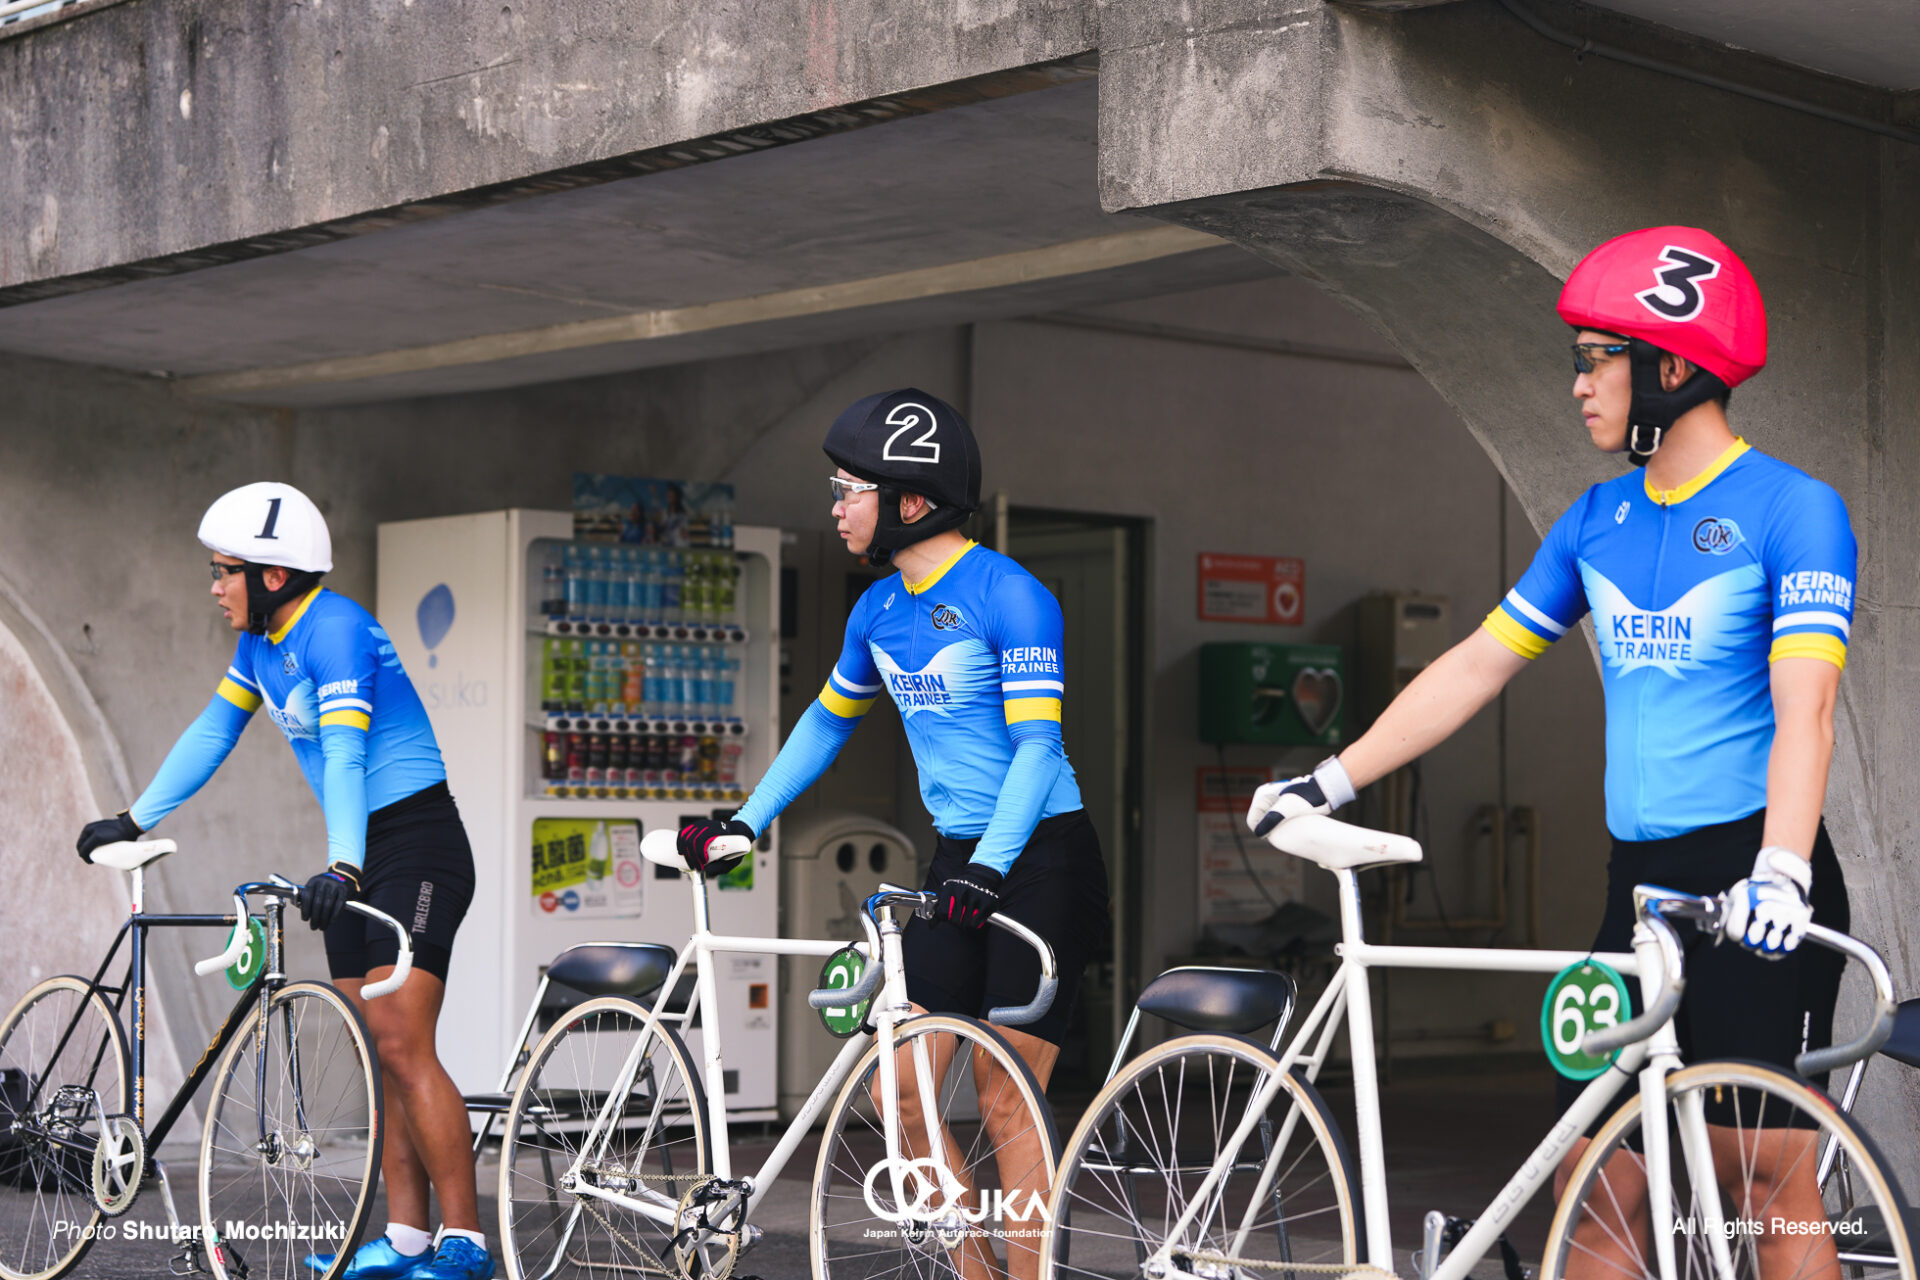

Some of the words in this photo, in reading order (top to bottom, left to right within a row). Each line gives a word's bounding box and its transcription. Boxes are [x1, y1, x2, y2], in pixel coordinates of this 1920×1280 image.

[1634, 245, 1721, 322] 3
[883, 402, 940, 463] 2
[254, 497, 281, 539] 1
[1780, 571, 1852, 598] KEIRIN
[1779, 589, 1852, 612] TRAINEE
[1612, 614, 1692, 640] KEIRIN
[1002, 646, 1057, 663] KEIRIN
[1614, 641, 1692, 661] TRAINEE
[1001, 662, 1060, 674] TRAINEE
[428, 670, 488, 710] suka
[889, 673, 946, 692] KEIRIN
[895, 693, 953, 707] TRAINEE
[826, 965, 860, 1018] 21
[1553, 983, 1619, 1055] 63
